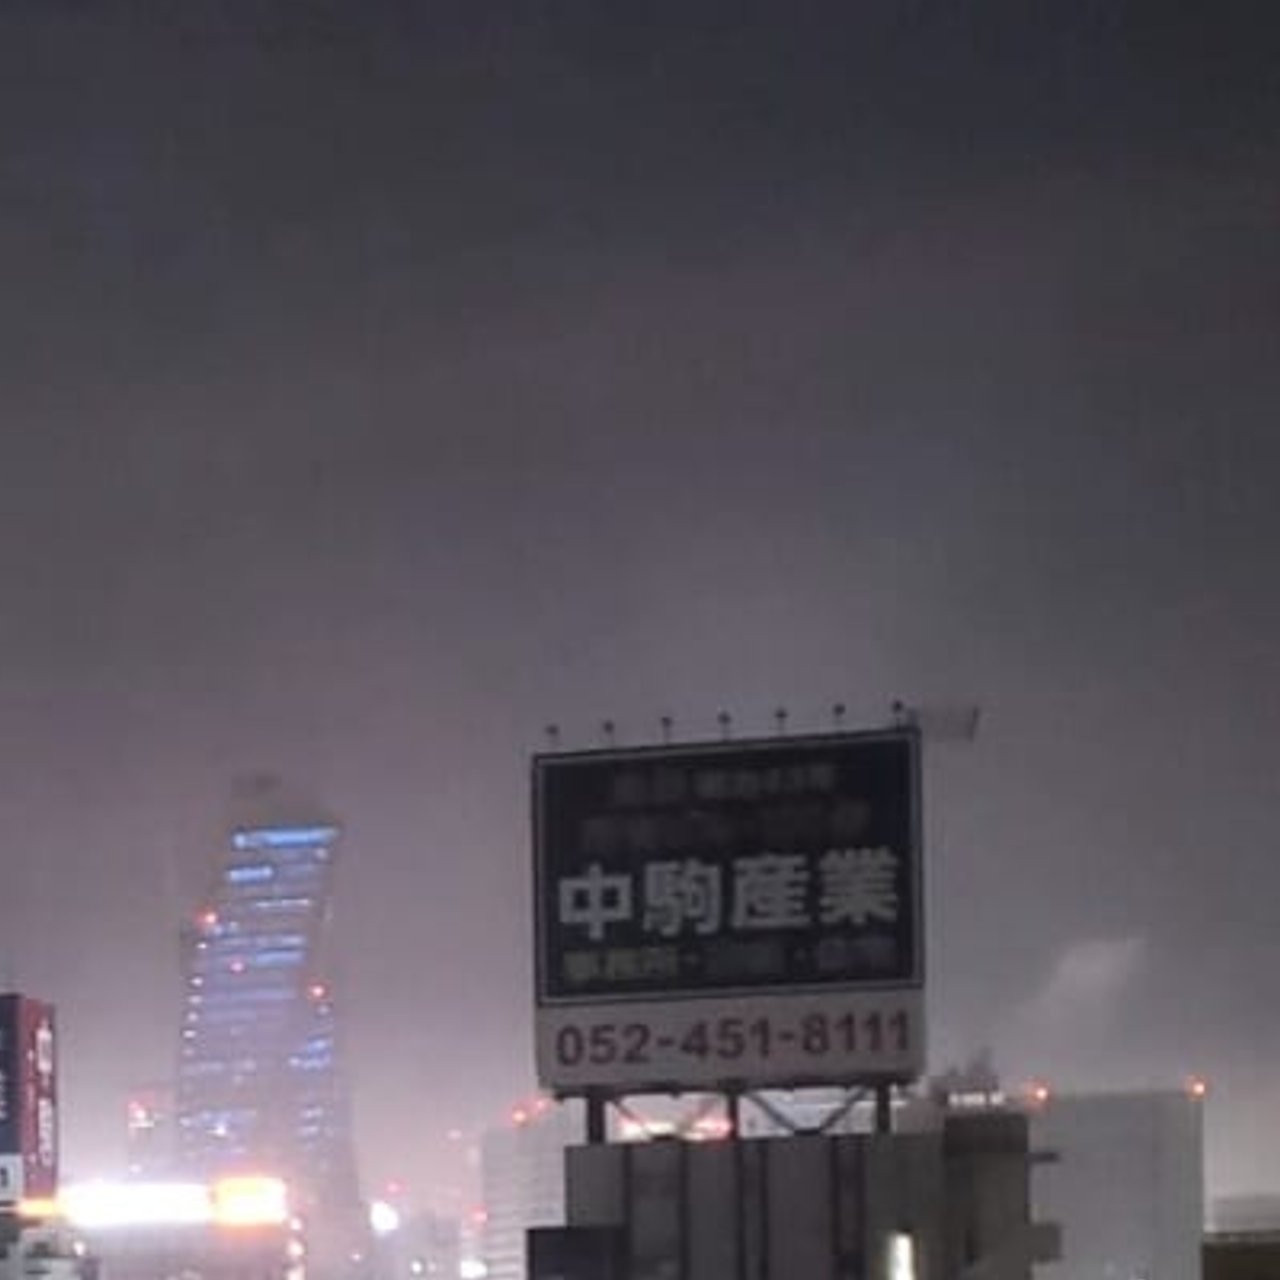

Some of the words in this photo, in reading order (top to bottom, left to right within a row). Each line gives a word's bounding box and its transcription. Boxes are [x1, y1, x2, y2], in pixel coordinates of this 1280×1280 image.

[557, 846, 899, 940] 中駒産業
[556, 1010, 910, 1066] 052-451-8111
